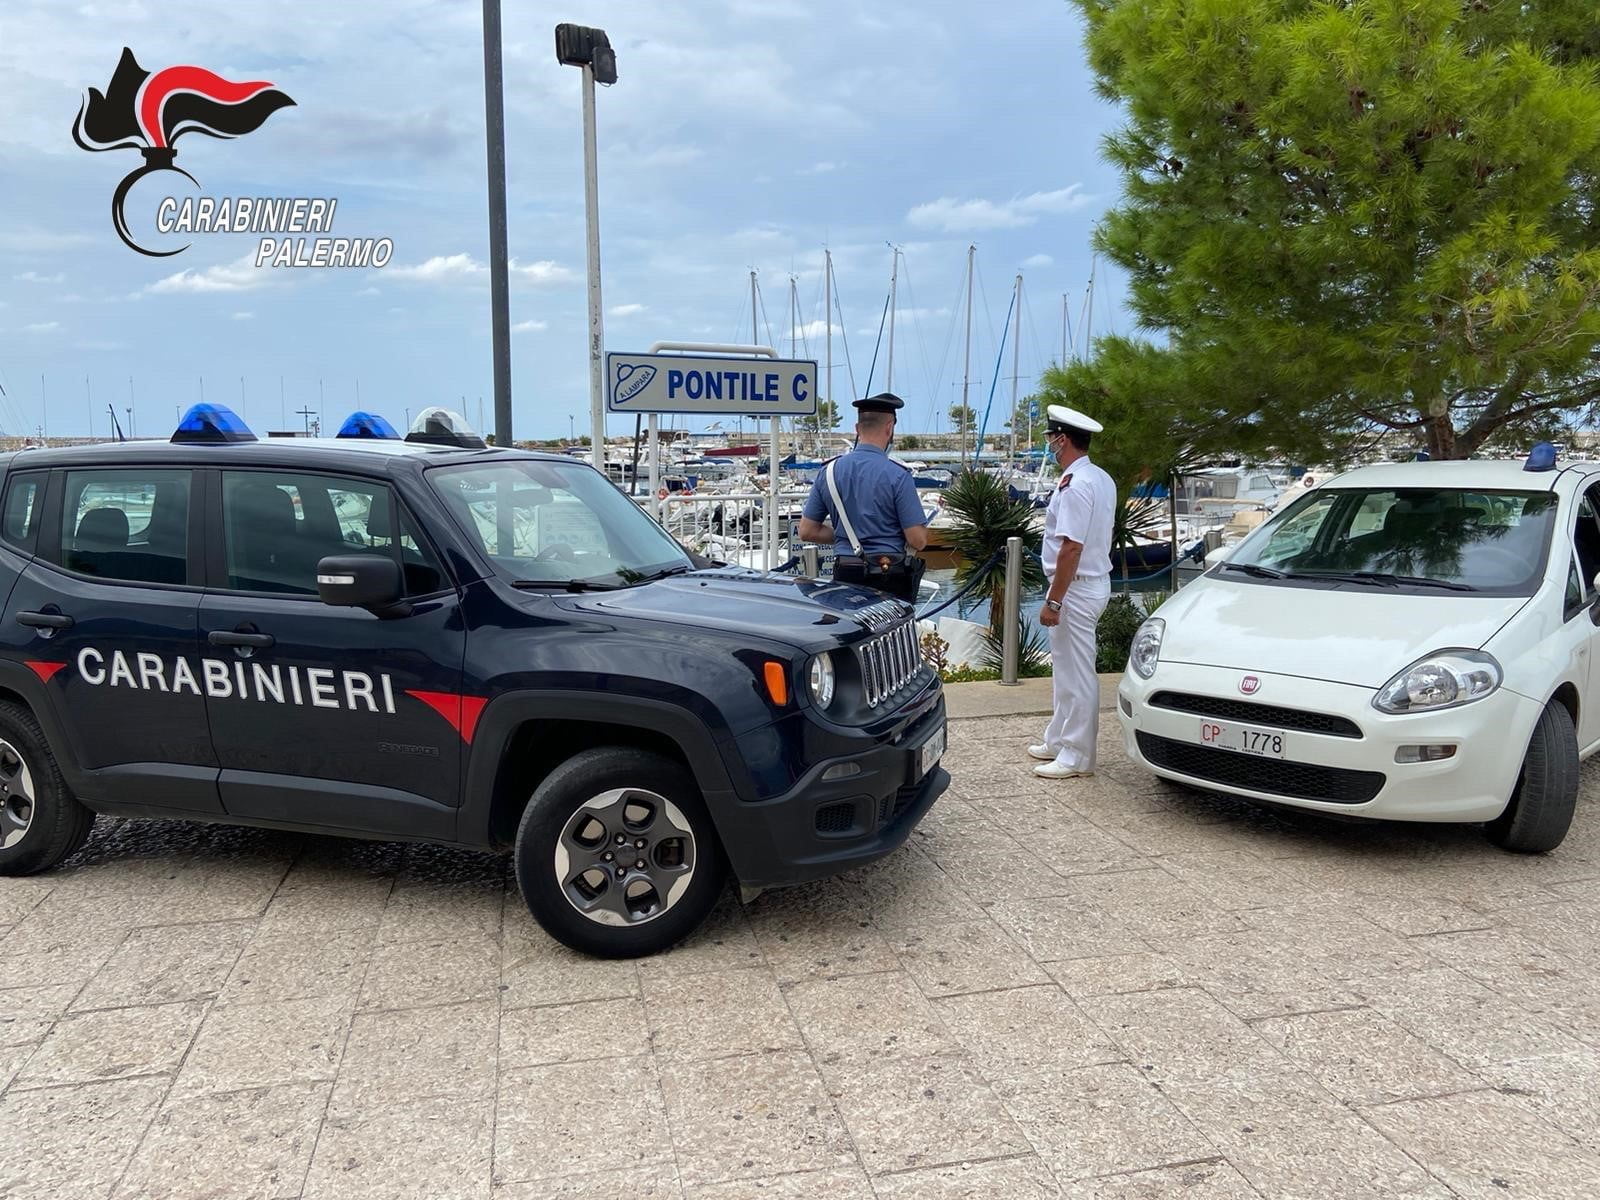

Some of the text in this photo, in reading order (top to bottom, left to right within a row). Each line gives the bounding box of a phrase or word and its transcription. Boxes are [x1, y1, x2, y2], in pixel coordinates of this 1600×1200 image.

[624, 371, 651, 396] LAMPARA
[668, 370, 808, 402] PONTILE C
[77, 646, 396, 714] CARABINIERI
[1242, 680, 1257, 689] FIAT
[1202, 724, 1220, 742] CP
[1242, 730, 1281, 753] 1778
